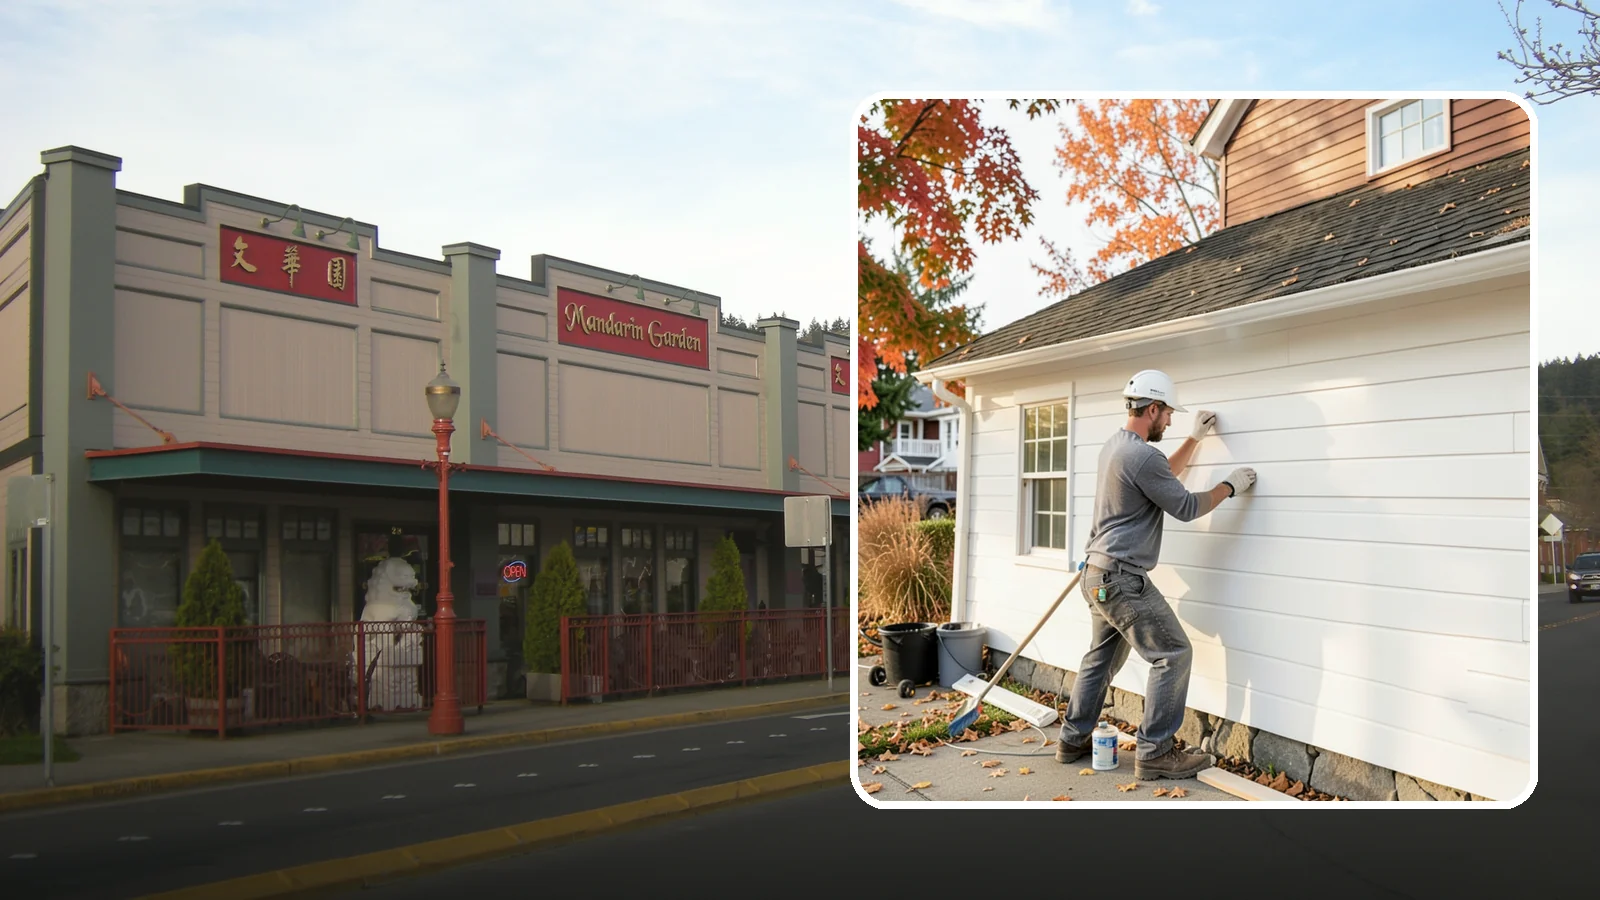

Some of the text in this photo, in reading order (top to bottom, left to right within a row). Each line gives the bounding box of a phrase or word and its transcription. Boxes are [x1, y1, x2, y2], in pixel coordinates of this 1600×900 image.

[231, 235, 346, 291] 文華園
[564, 302, 701, 352] Mandarin Garden
[503, 565, 527, 578] OPEN
